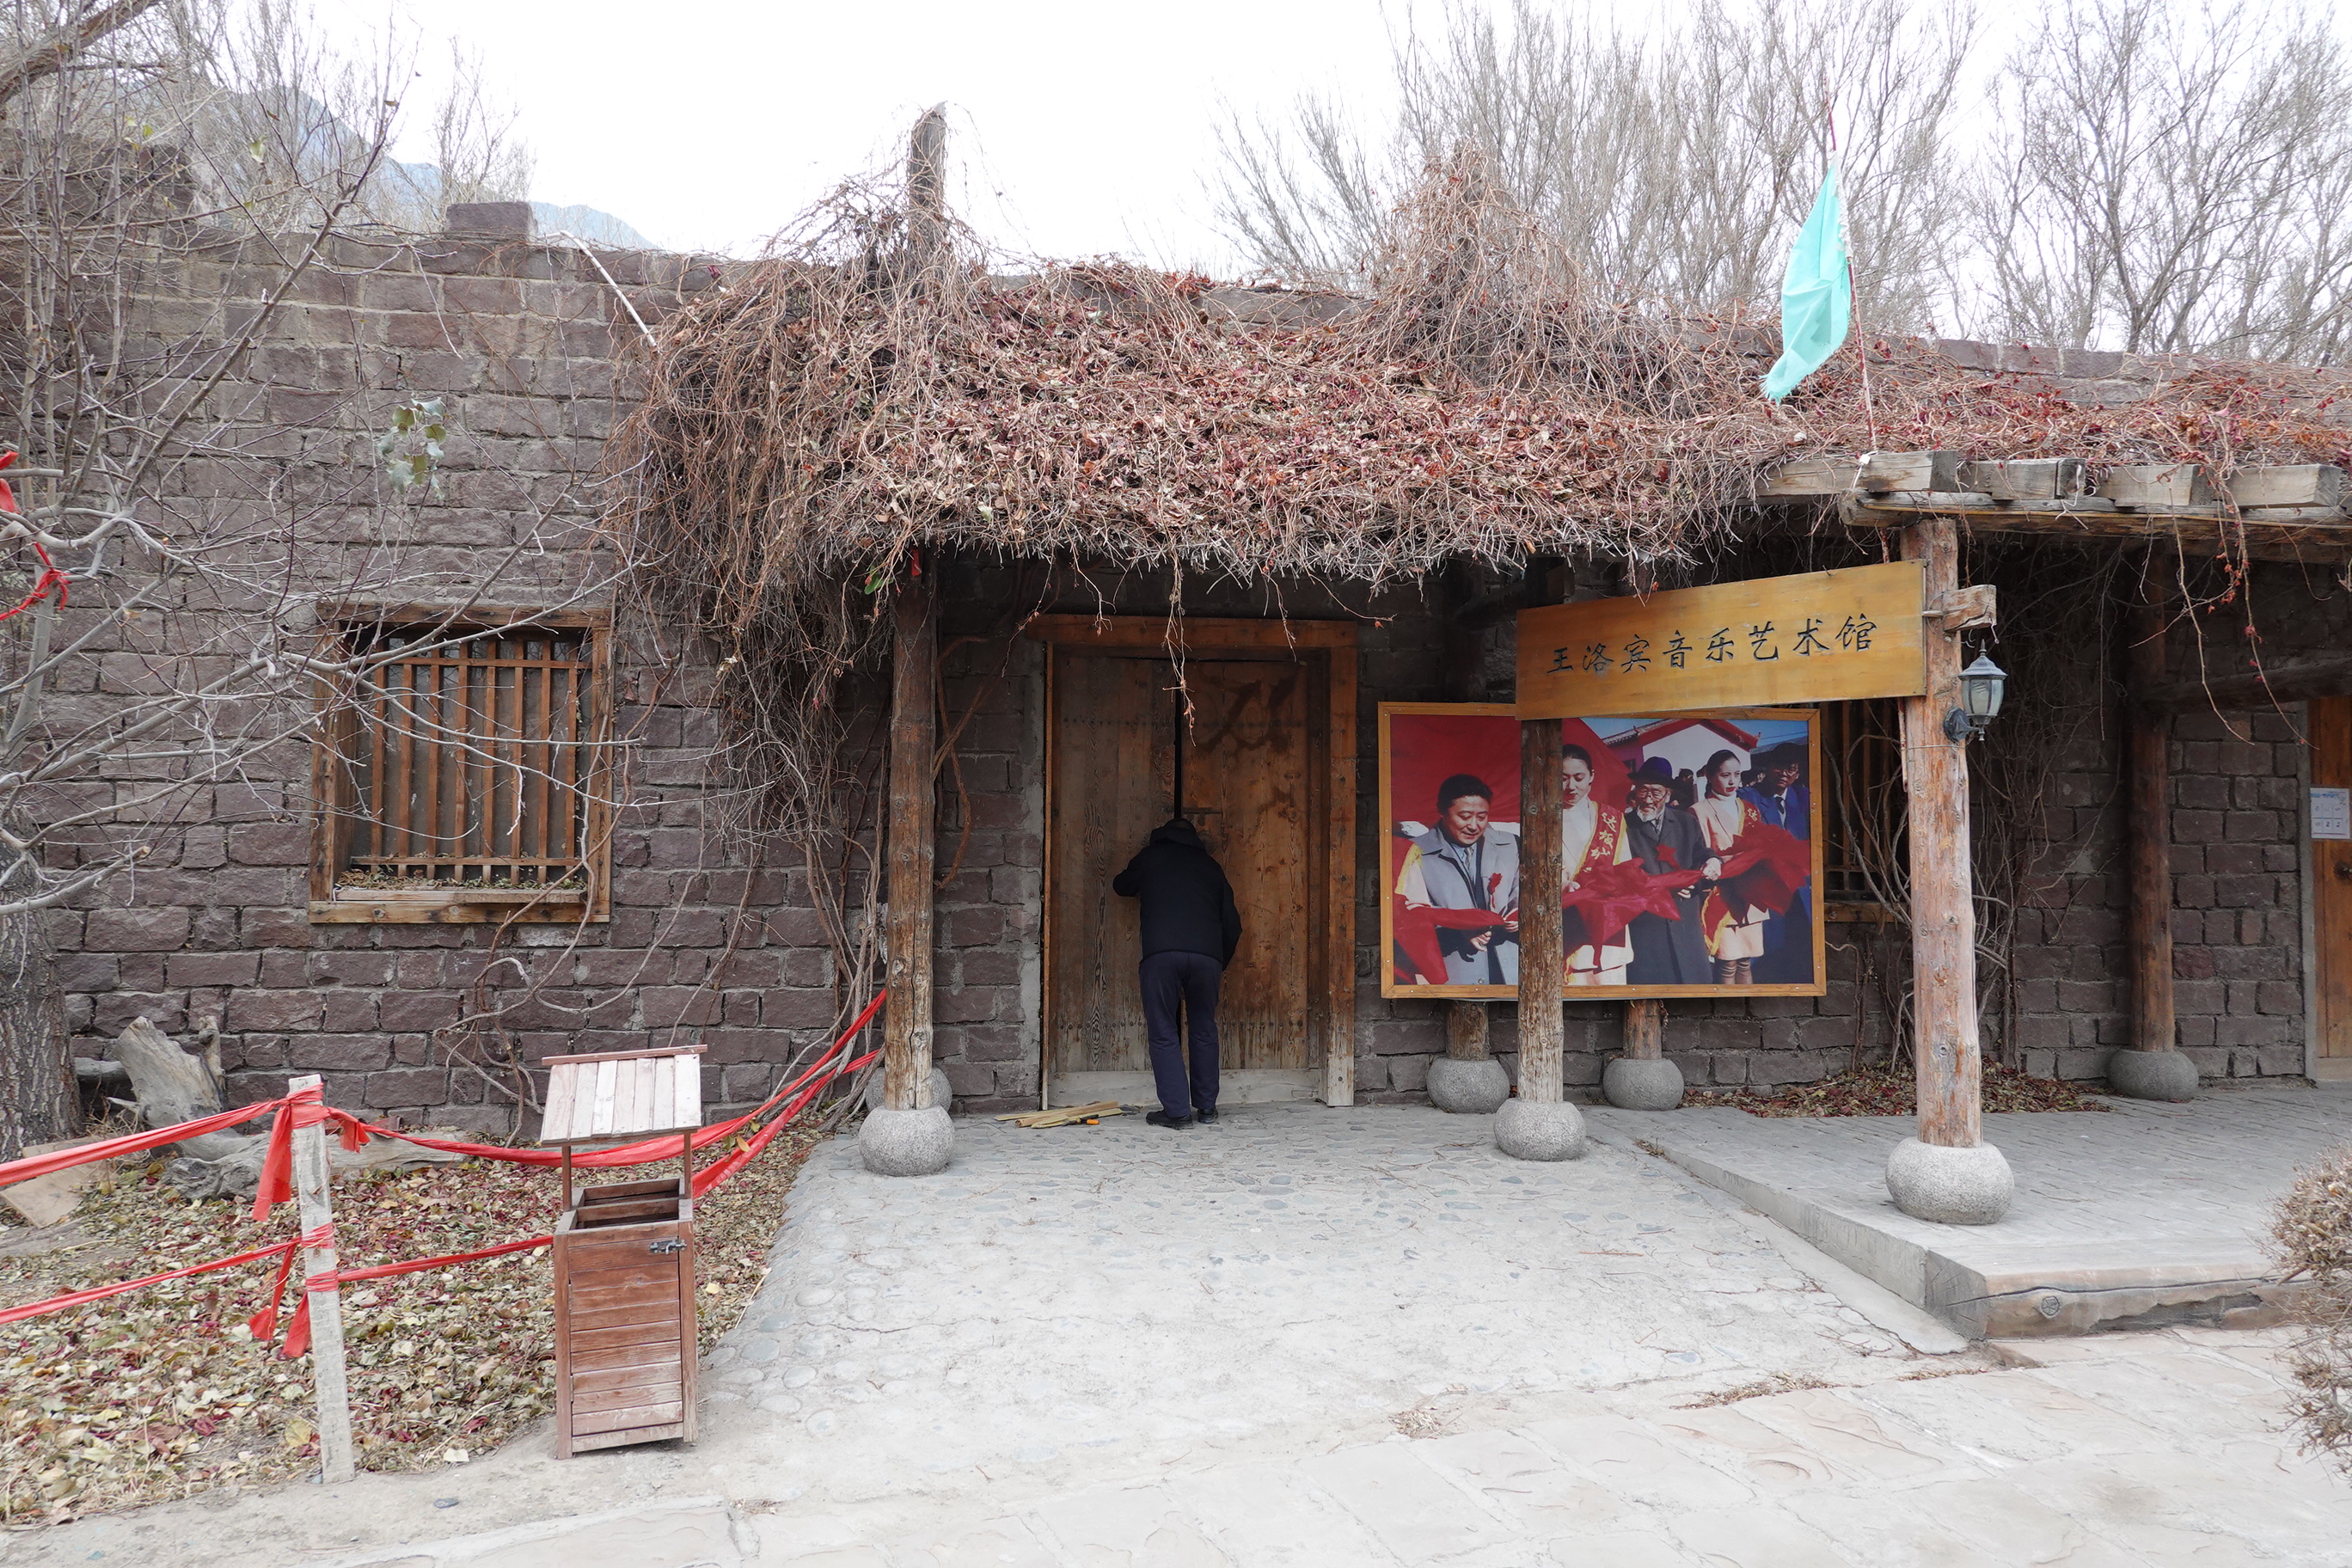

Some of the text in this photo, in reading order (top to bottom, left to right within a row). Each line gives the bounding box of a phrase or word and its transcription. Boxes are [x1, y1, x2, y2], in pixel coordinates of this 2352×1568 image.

[1547, 613, 1877, 674] 王洛宾音乐艺术馆
